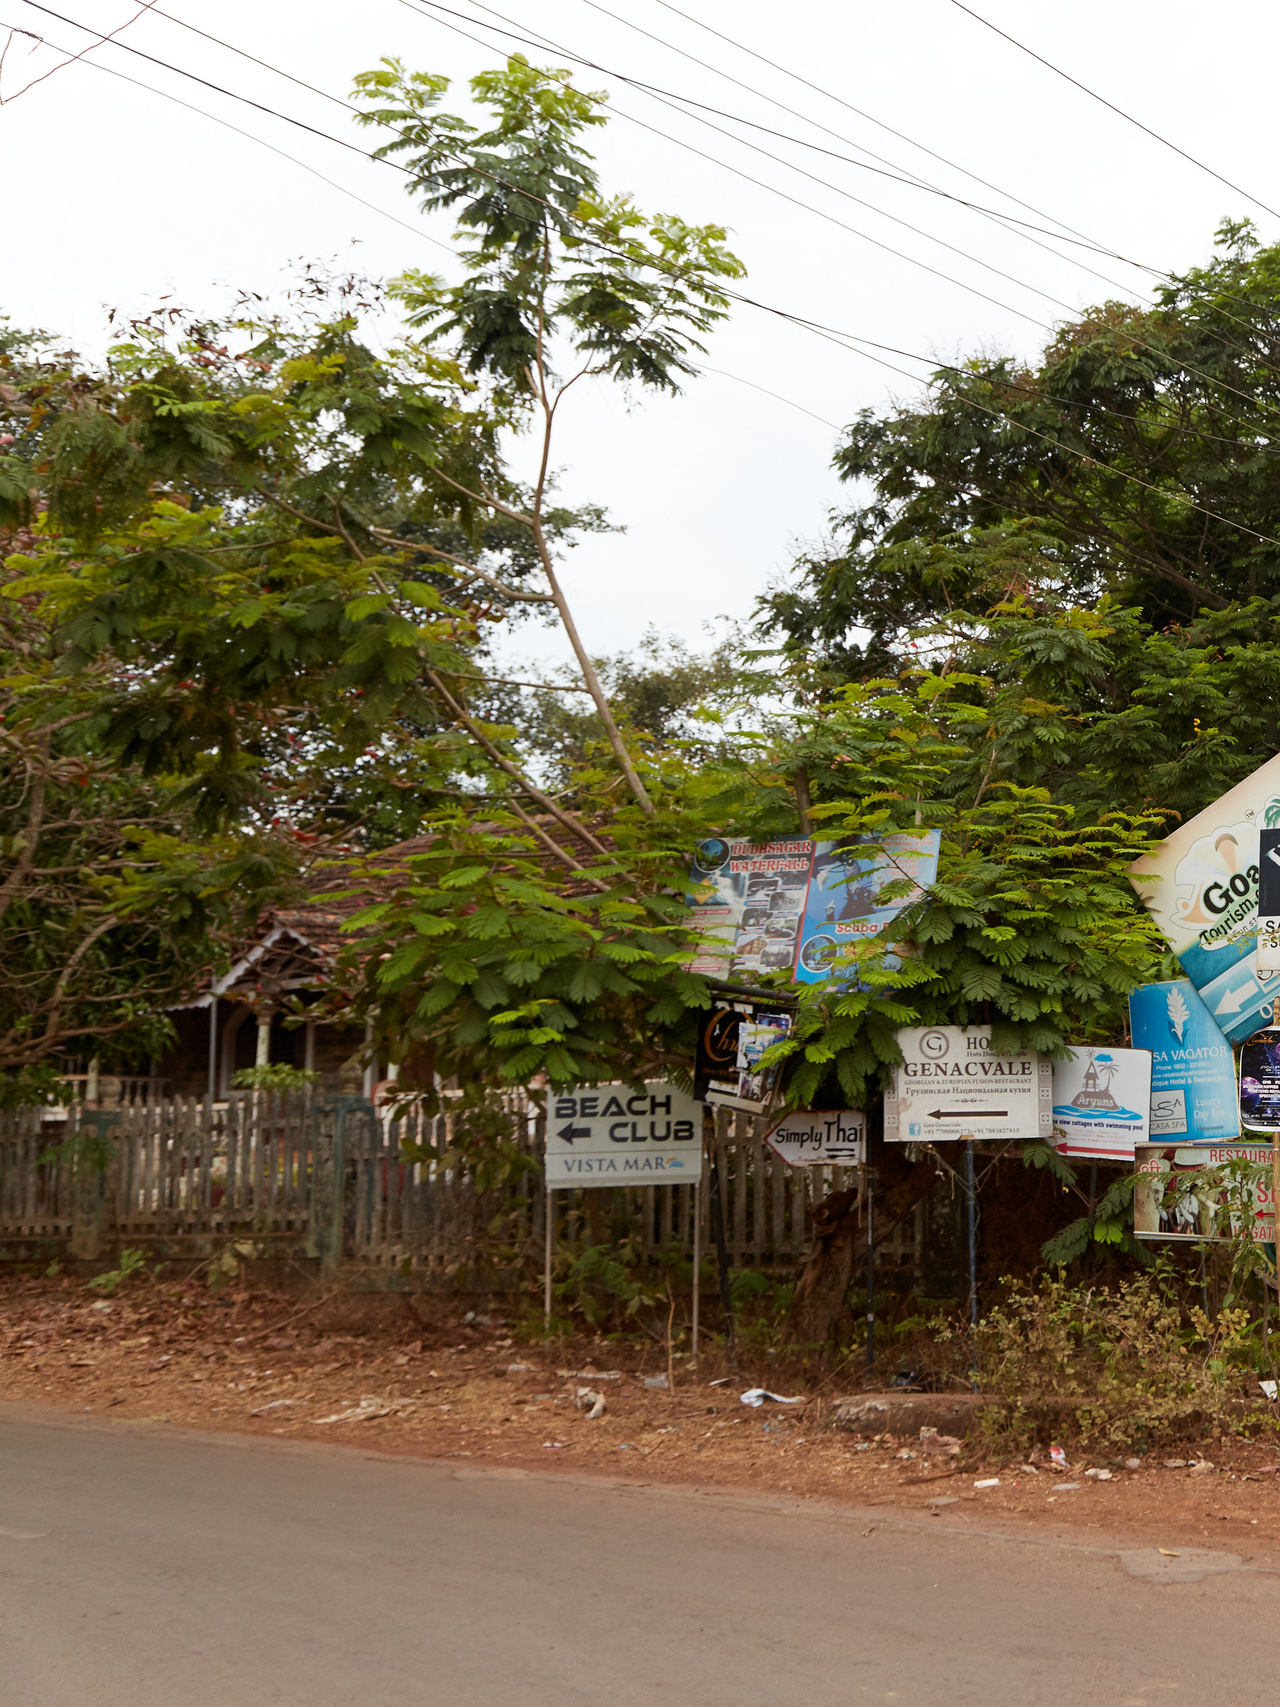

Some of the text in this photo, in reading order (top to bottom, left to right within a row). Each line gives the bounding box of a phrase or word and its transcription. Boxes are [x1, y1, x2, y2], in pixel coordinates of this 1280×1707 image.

[732, 840, 812, 856] DUDHSAGAR
[1203, 864, 1259, 914] Goa
[835, 922, 877, 934] Scuba
[1172, 1046, 1228, 1060] VAGATOR
[904, 1062, 1033, 1077] GENACVALE
[1170, 1077, 1186, 1085] Hotel
[906, 1087, 950, 1096] Грузинская
[952, 1087, 1008, 1095] Национальная
[555, 1095, 671, 1119] BEACH
[1077, 1094, 1114, 1108] Aryans
[1196, 1098, 1221, 1107] Luxury
[1193, 1109, 1226, 1120] Day Spa
[1106, 1123, 1131, 1131] swimming
[1172, 1120, 1185, 1129] SPA
[609, 1121, 694, 1143] CLUB
[775, 1114, 863, 1150] Simply Thai
[563, 1156, 666, 1173] VISTA MAR
